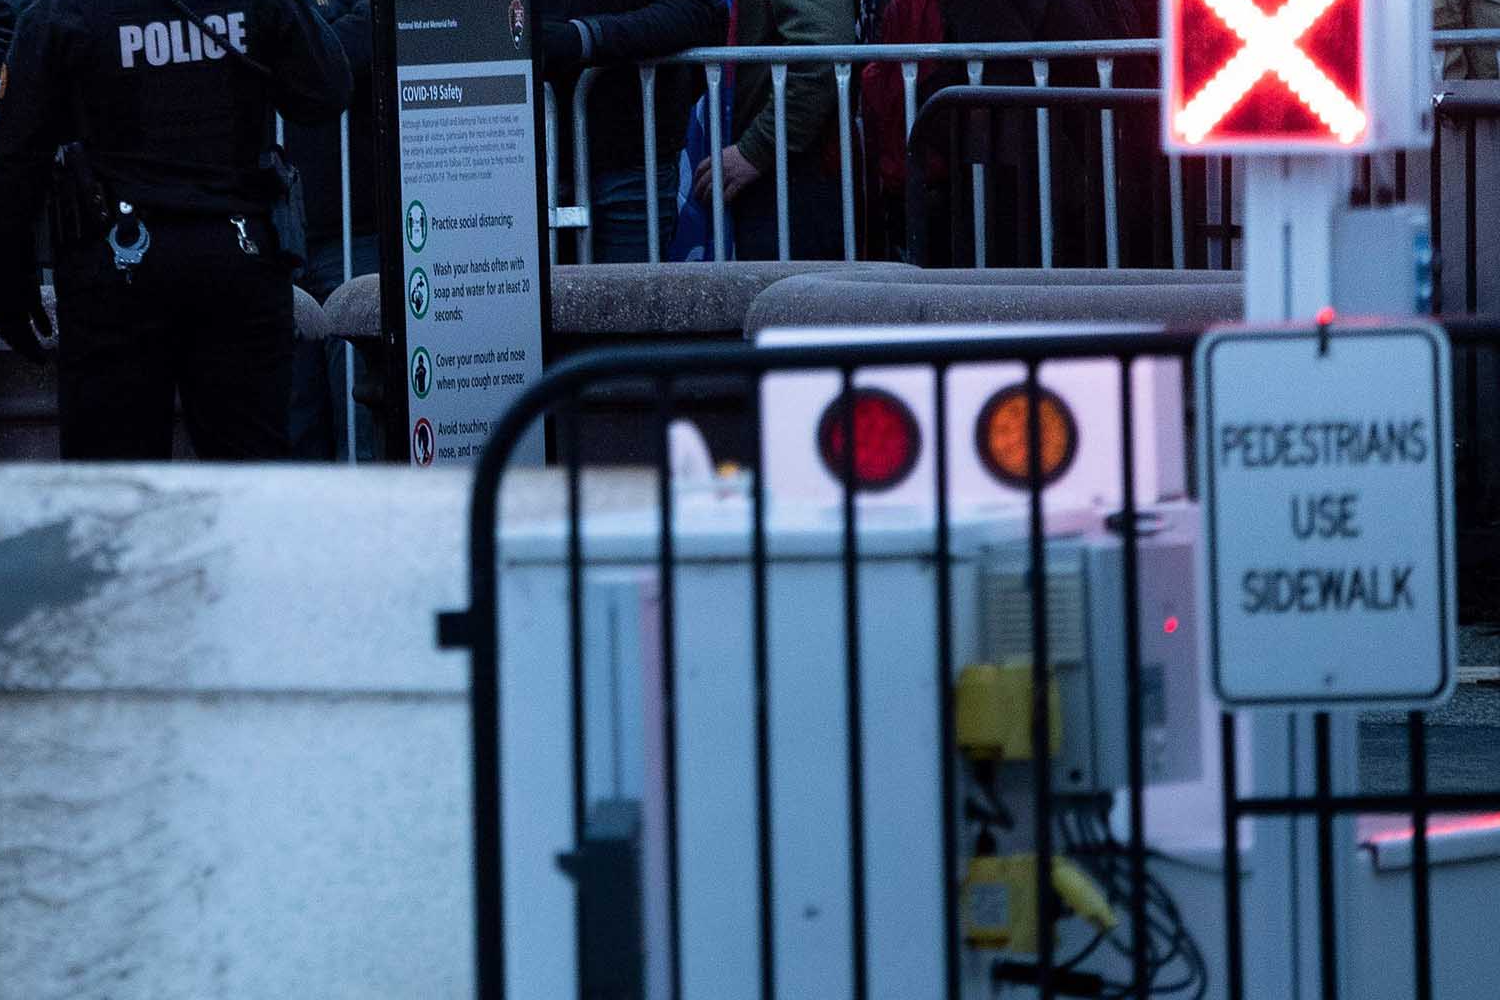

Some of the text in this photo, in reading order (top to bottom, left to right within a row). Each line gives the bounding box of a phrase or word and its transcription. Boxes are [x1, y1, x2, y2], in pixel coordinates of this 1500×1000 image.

[118, 11, 248, 69] POLICE
[402, 83, 463, 103] COVID-19 Safety
[432, 215, 458, 230] Practice
[459, 213, 478, 228] social
[433, 255, 525, 279] Wash your hands often with
[433, 279, 531, 301] soap and water for at least 20
[435, 347, 526, 369] Cover your mouth and nose
[436, 375, 456, 390] when
[457, 378, 471, 392] you
[470, 373, 492, 390] cough
[492, 374, 500, 385] or
[437, 420, 458, 435] Avoid
[459, 418, 489, 435] touching
[438, 447, 457, 459] nose,
[457, 443, 471, 457] and
[1221, 418, 1428, 468] PEDESTRIANS
[1291, 494, 1361, 540] USE
[1242, 565, 1415, 614] SIDEWALK
